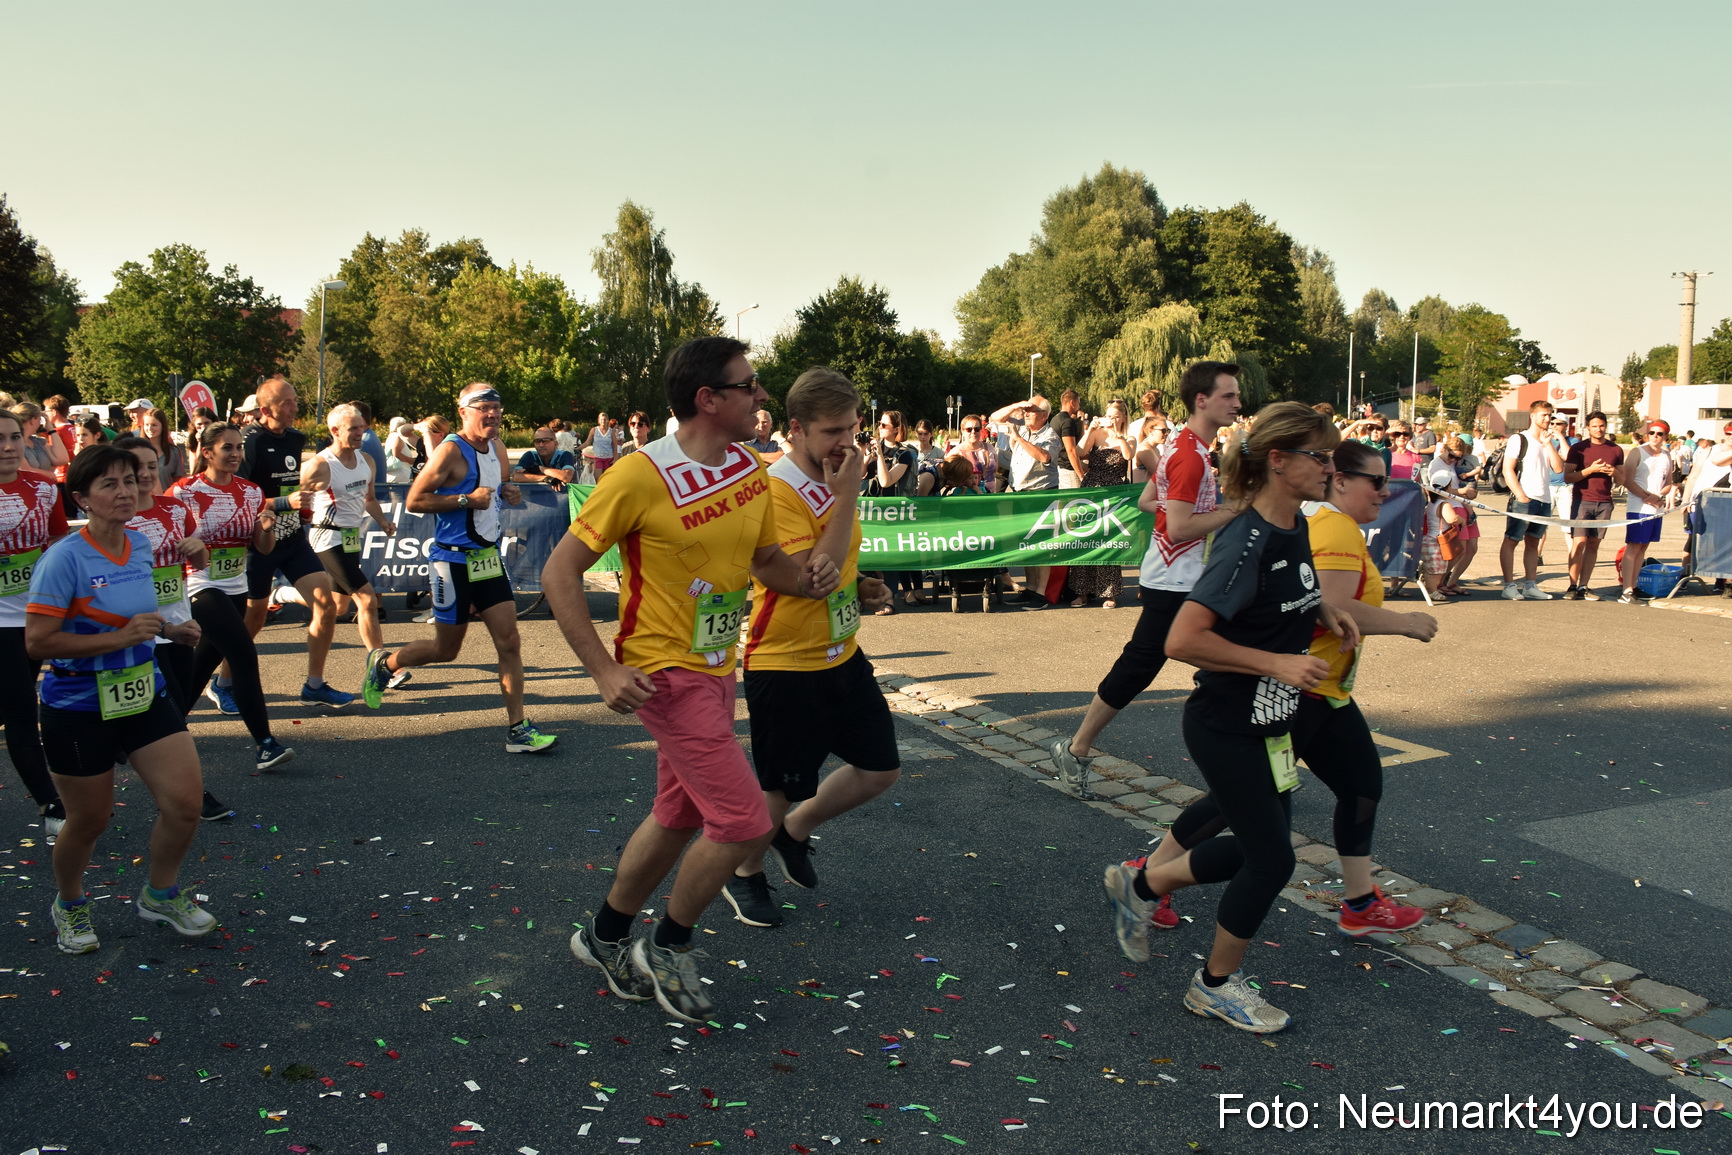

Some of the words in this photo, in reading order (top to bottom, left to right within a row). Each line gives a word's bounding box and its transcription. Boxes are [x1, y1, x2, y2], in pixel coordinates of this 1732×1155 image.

[681, 498, 732, 531] MAX
[734, 478, 768, 507] BÖGL
[1023, 497, 1131, 540] AOK
[345, 536, 360, 546] 21
[362, 530, 518, 560] Fiscr
[898, 530, 995, 552] Händen
[1019, 542, 1036, 551] Die
[1038, 540, 1132, 550] Gesundheitskasse.
[471, 557, 498, 573] 2114
[836, 600, 860, 626] 133
[109, 675, 151, 703] 1591
